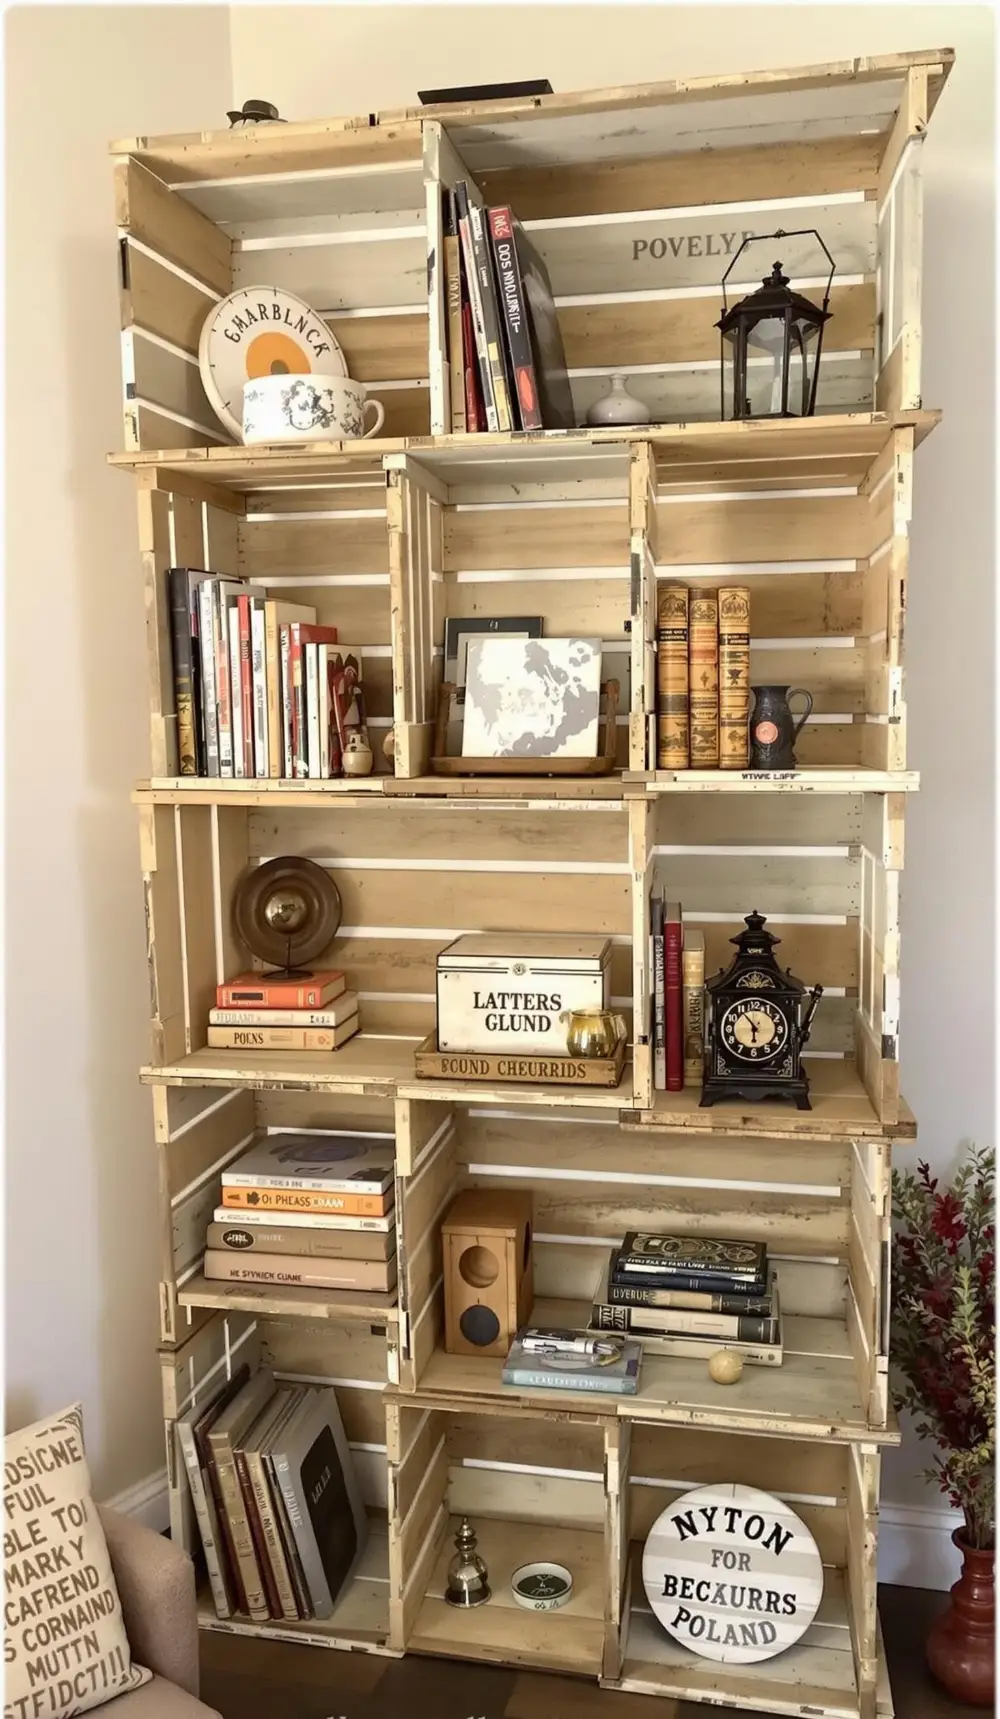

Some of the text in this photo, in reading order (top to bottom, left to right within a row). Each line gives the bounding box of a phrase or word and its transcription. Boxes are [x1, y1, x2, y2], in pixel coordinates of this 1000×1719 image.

[473, 991, 562, 1011] LATTERS
[485, 1013, 552, 1033] GLUND
[750, 1047, 758, 1057] 6
[670, 1506, 794, 1556] NYTON
[711, 1548, 752, 1572] FOR
[22, 1588, 115, 1653] CORNAIND
[670, 1606, 777, 1646] POLAND
[25, 1629, 100, 1687] MUTTN
